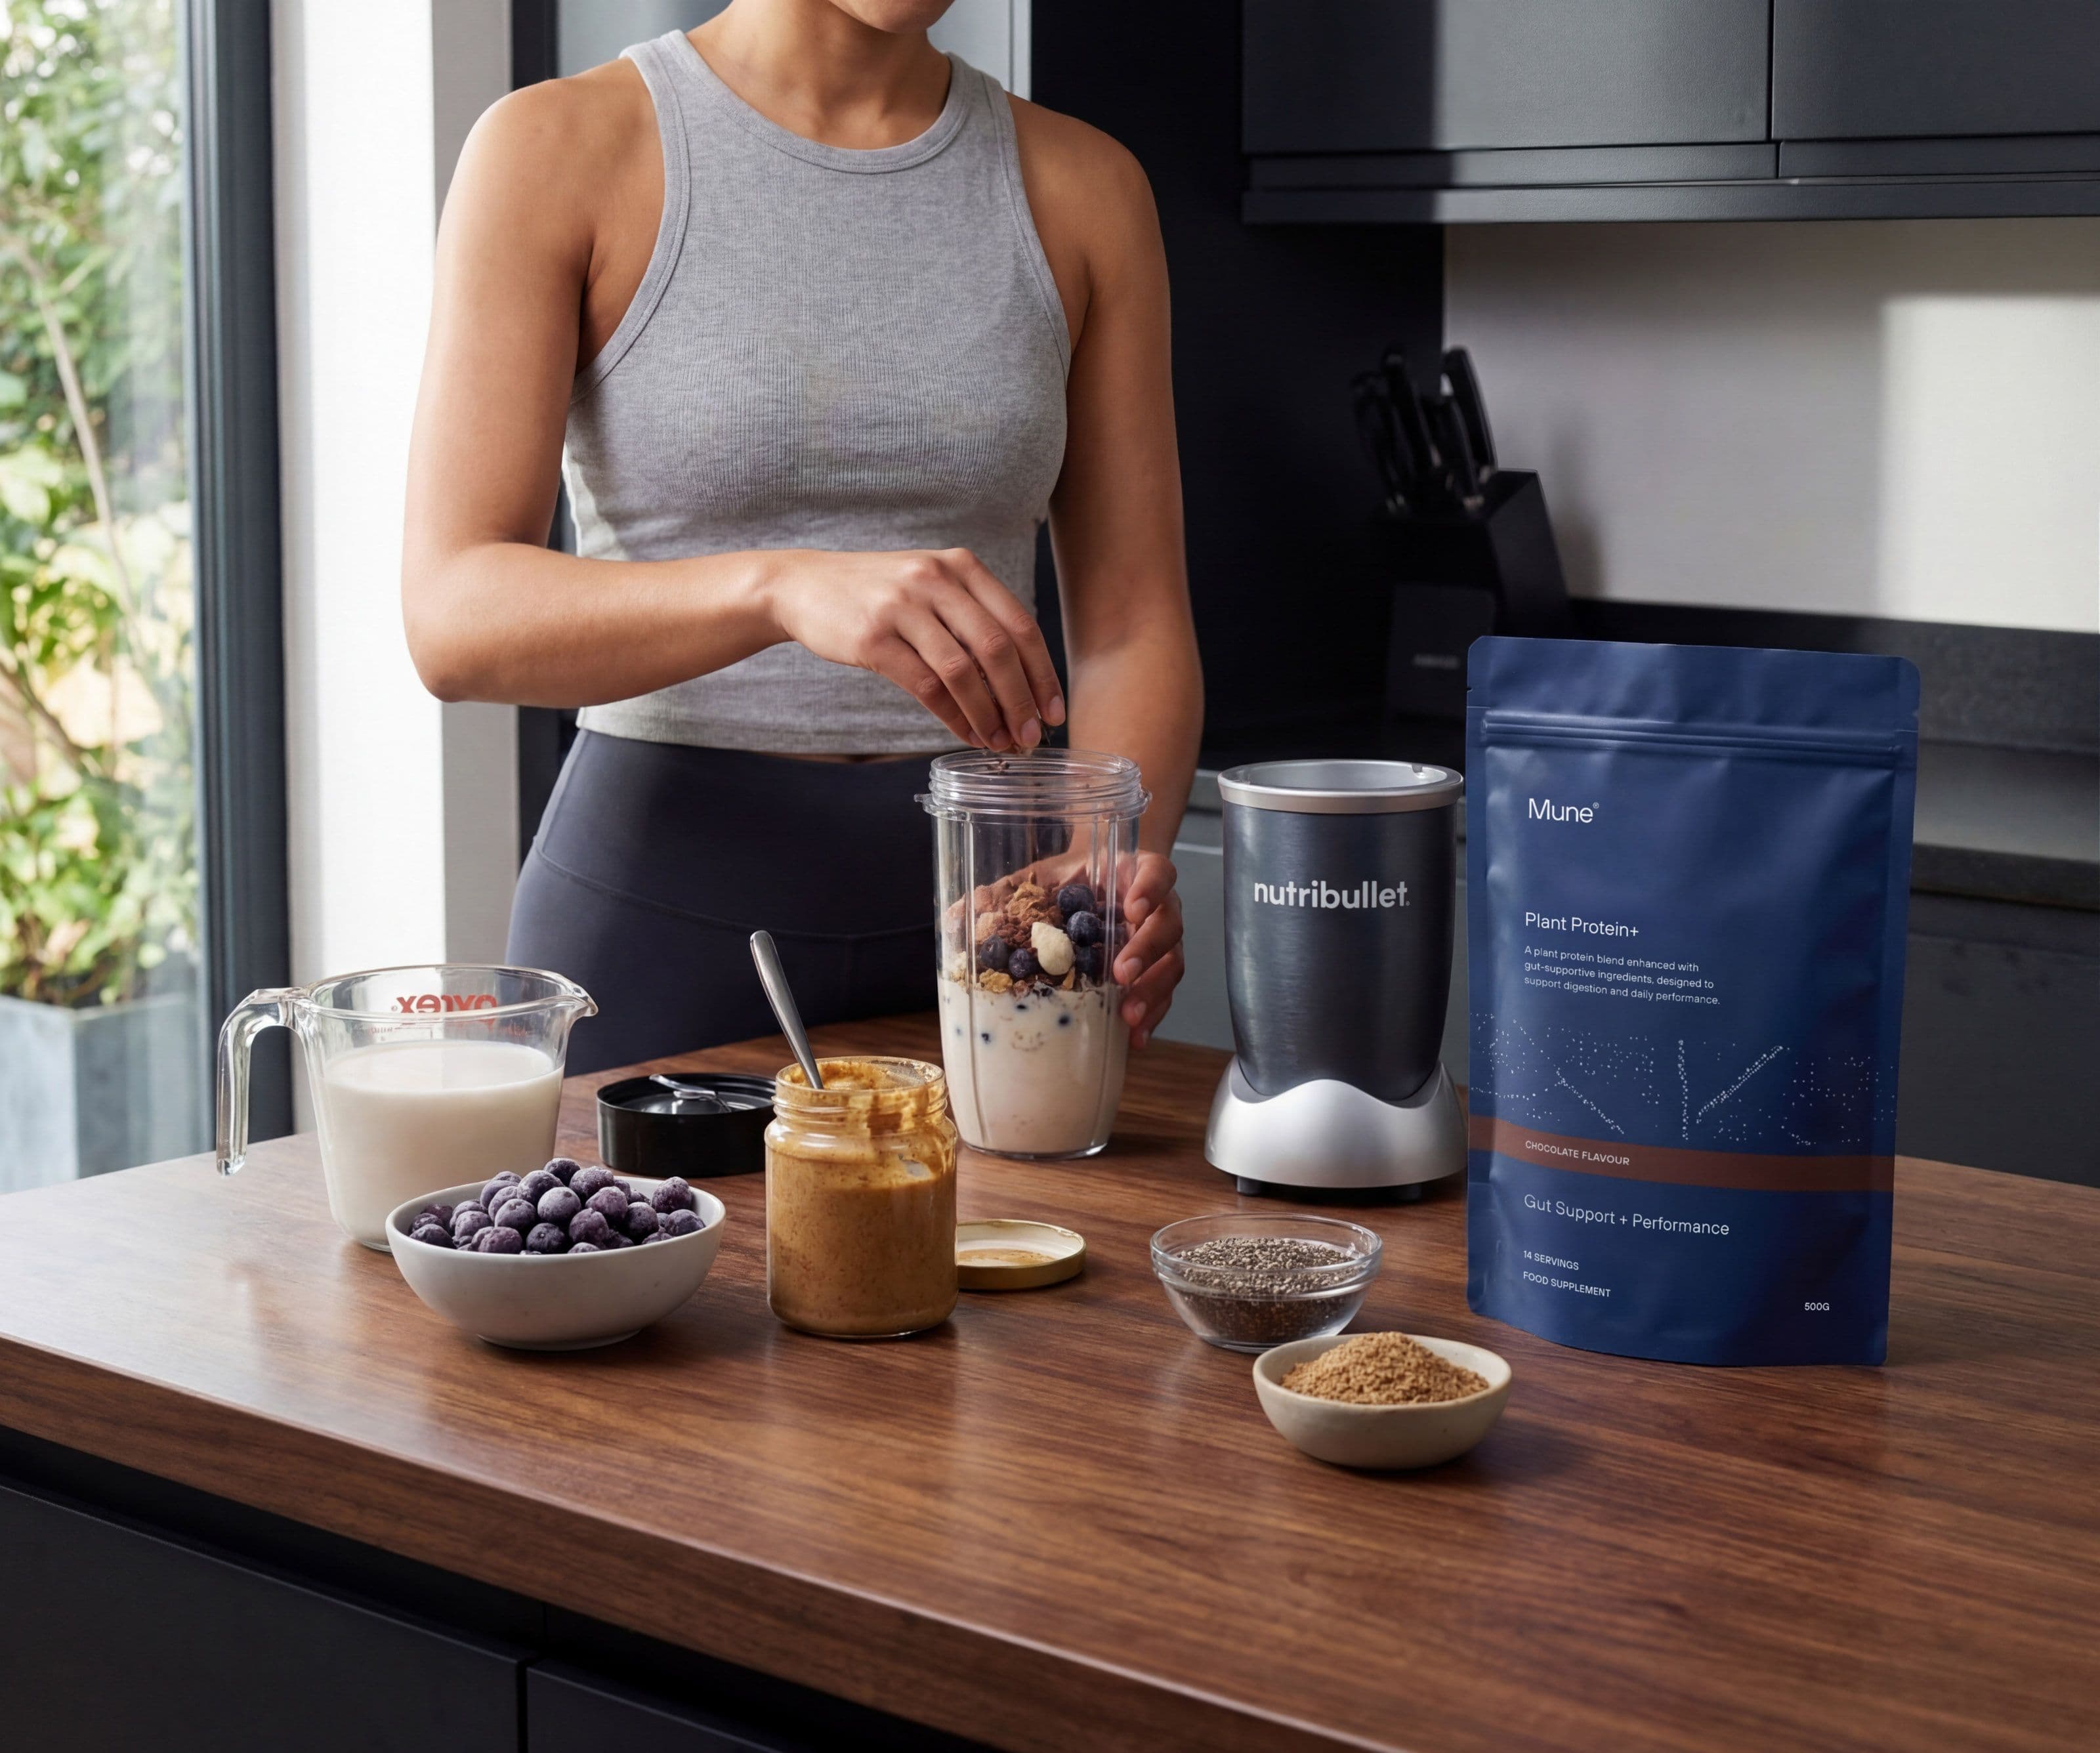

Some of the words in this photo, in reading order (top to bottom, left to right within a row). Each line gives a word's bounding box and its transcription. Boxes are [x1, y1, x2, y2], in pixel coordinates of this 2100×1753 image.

[1525, 912, 1567, 931] Plant
[1571, 916, 1639, 937] Protein+
[1524, 946, 1532, 954] A
[1534, 948, 1558, 958] plant
[1561, 952, 1594, 961] protein
[1597, 954, 1624, 965] blend
[1627, 958, 1675, 970] enhanced
[1677, 961, 1699, 972] with
[1524, 962, 1595, 978] gut-supportive
[1598, 969, 1654, 984] ingredients,
[1656, 976, 1702, 989] designed
[1704, 980, 1714, 989] to
[1524, 977, 1561, 988] support
[1563, 981, 1607, 994] digestion
[1610, 988, 1628, 997] and
[1631, 988, 1654, 1002] daily
[1656, 992, 1720, 1005] performance.
[1525, 1140, 1579, 1158] CHOCOLATE
[1582, 1151, 1629, 1166] FLAVOUR
[1524, 1194, 1551, 1212] Gut
[1556, 1201, 1615, 1225] Support
[1619, 1215, 1628, 1225] +
[1633, 1214, 1730, 1235] Performance
[1523, 1250, 1532, 1259] 14
[1534, 1253, 1580, 1271] SERVINGS
[1523, 1271, 1549, 1285] FOOD
[1550, 1278, 1611, 1298] SUPPLEMENT
[1804, 1301, 1830, 1311] 500G
